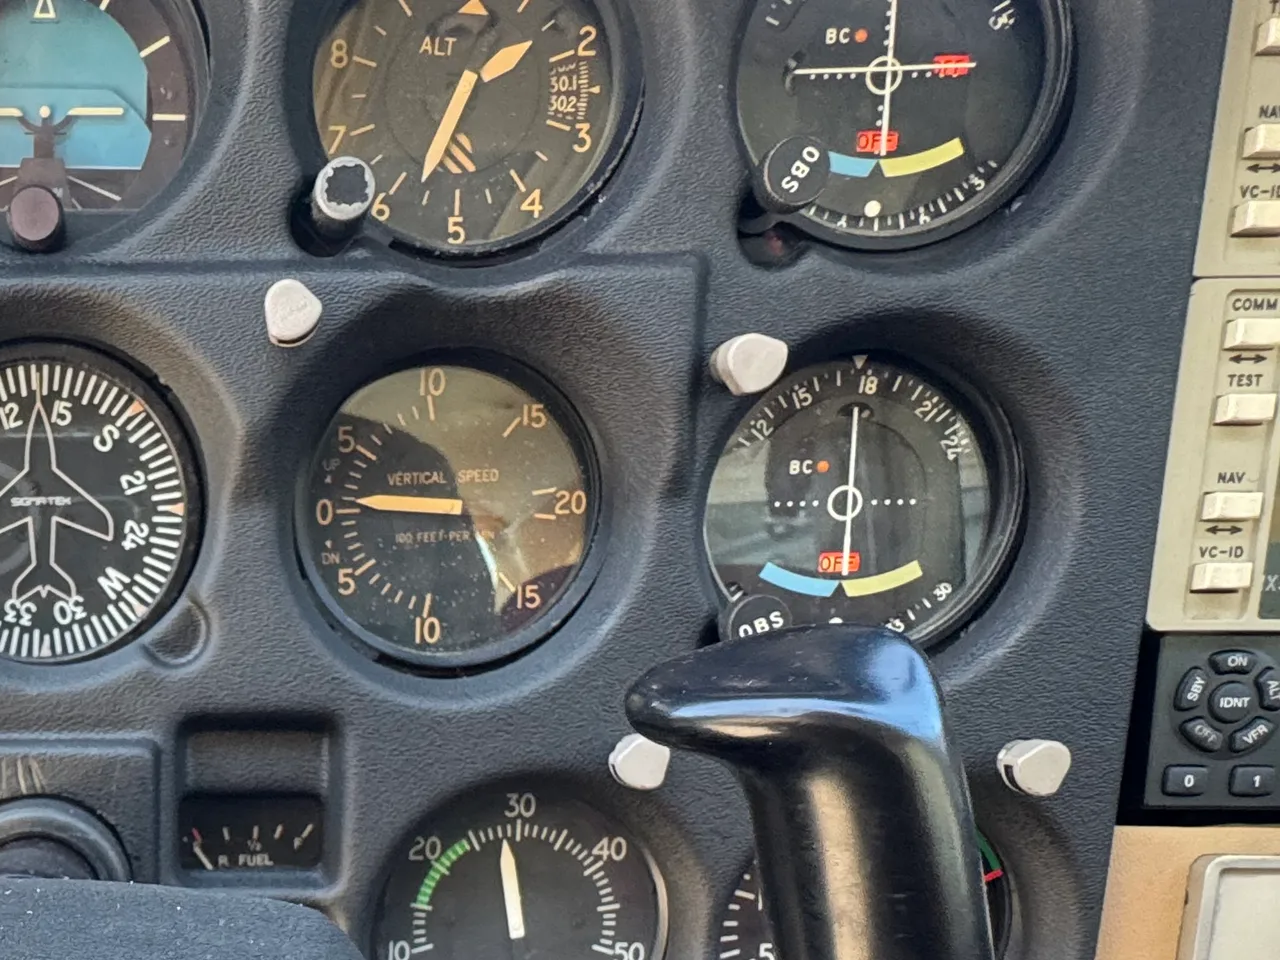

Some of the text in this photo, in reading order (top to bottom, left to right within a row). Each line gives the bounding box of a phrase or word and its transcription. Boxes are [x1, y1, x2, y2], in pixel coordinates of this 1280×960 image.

[419, 36, 458, 57] ALT
[577, 25, 597, 57] 2
[825, 27, 851, 45] BC
[330, 38, 349, 69] 8
[327, 124, 348, 155] 7
[572, 122, 593, 153] 3
[780, 145, 821, 195] OBS
[371, 191, 391, 222] 6
[520, 188, 543, 219] 4
[447, 215, 466, 245] 5
[1232, 298, 1279, 311] COMM
[419, 367, 446, 397] 10
[858, 376, 879, 395] 18
[1227, 374, 1264, 388] TEST
[792, 387, 814, 409] 15
[50, 399, 73, 427] 15
[522, 403, 548, 428] 15
[914, 400, 938, 423] 21
[92, 424, 120, 453] S
[337, 425, 355, 454] 5
[750, 419, 774, 442] 12
[939, 434, 963, 461] 24
[321, 458, 341, 472] UP
[386, 468, 500, 487] VERTICAL SPEED
[788, 459, 814, 476] BC
[1217, 471, 1247, 485] NAV
[119, 469, 148, 496] 21
[315, 499, 334, 526] 0
[554, 490, 588, 516] 20
[120, 519, 150, 551] 24
[321, 552, 340, 566] DN
[1199, 546, 1245, 559] VC-ID
[337, 567, 356, 596] 5
[516, 584, 542, 610] 15
[3, 598, 38, 627] 33
[52, 595, 88, 626] 30
[414, 615, 442, 645] 10
[738, 610, 785, 638] OBS
[1227, 655, 1249, 668] ON
[1186, 676, 1207, 702] SBY
[1219, 696, 1251, 709] IDNT
[1194, 724, 1219, 744] OFF
[1242, 723, 1269, 745] VFR
[1183, 774, 1195, 789] 0
[1252, 774, 1262, 788] 1
[504, 792, 537, 818] 30
[217, 853, 275, 868] R FUEL
[408, 836, 442, 862] 20
[591, 836, 628, 861] 40
